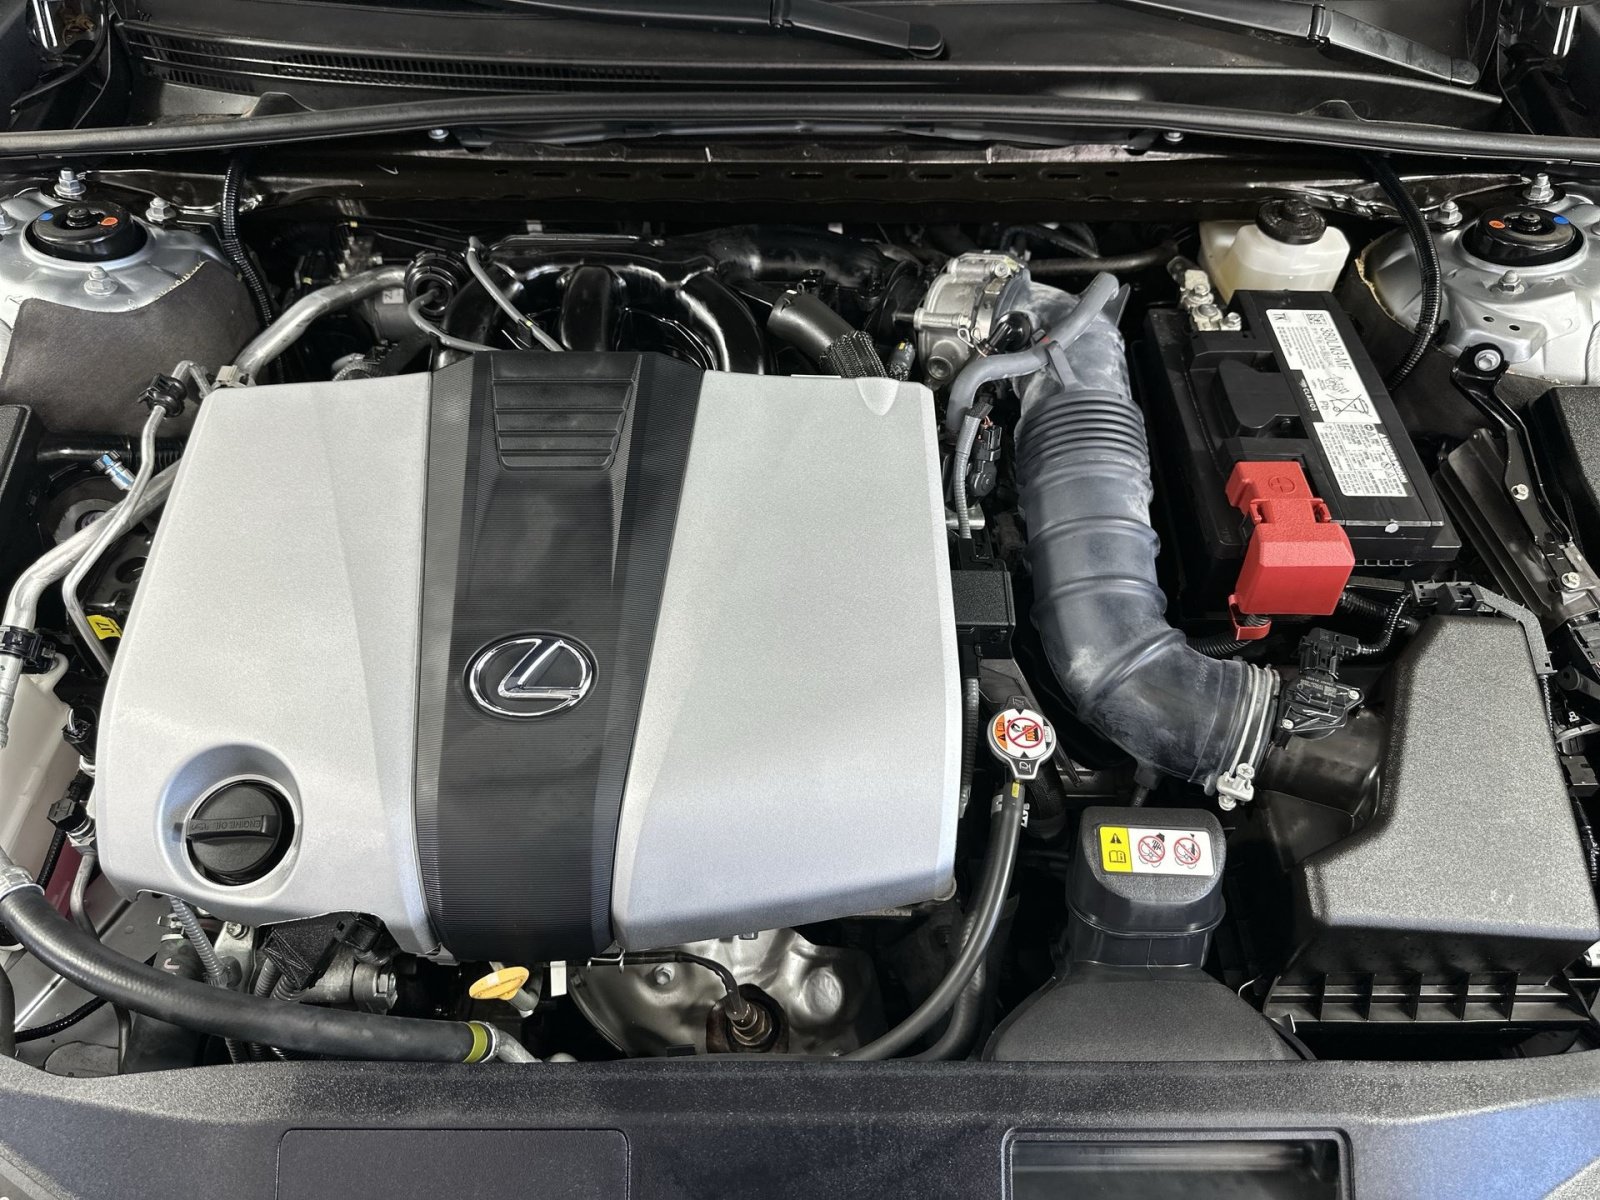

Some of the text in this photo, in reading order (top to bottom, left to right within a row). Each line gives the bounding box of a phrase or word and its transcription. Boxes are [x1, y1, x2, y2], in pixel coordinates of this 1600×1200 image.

[1302, 387, 1318, 412] CLARIOS
[215, 819, 261, 830] ENGINE OIL
